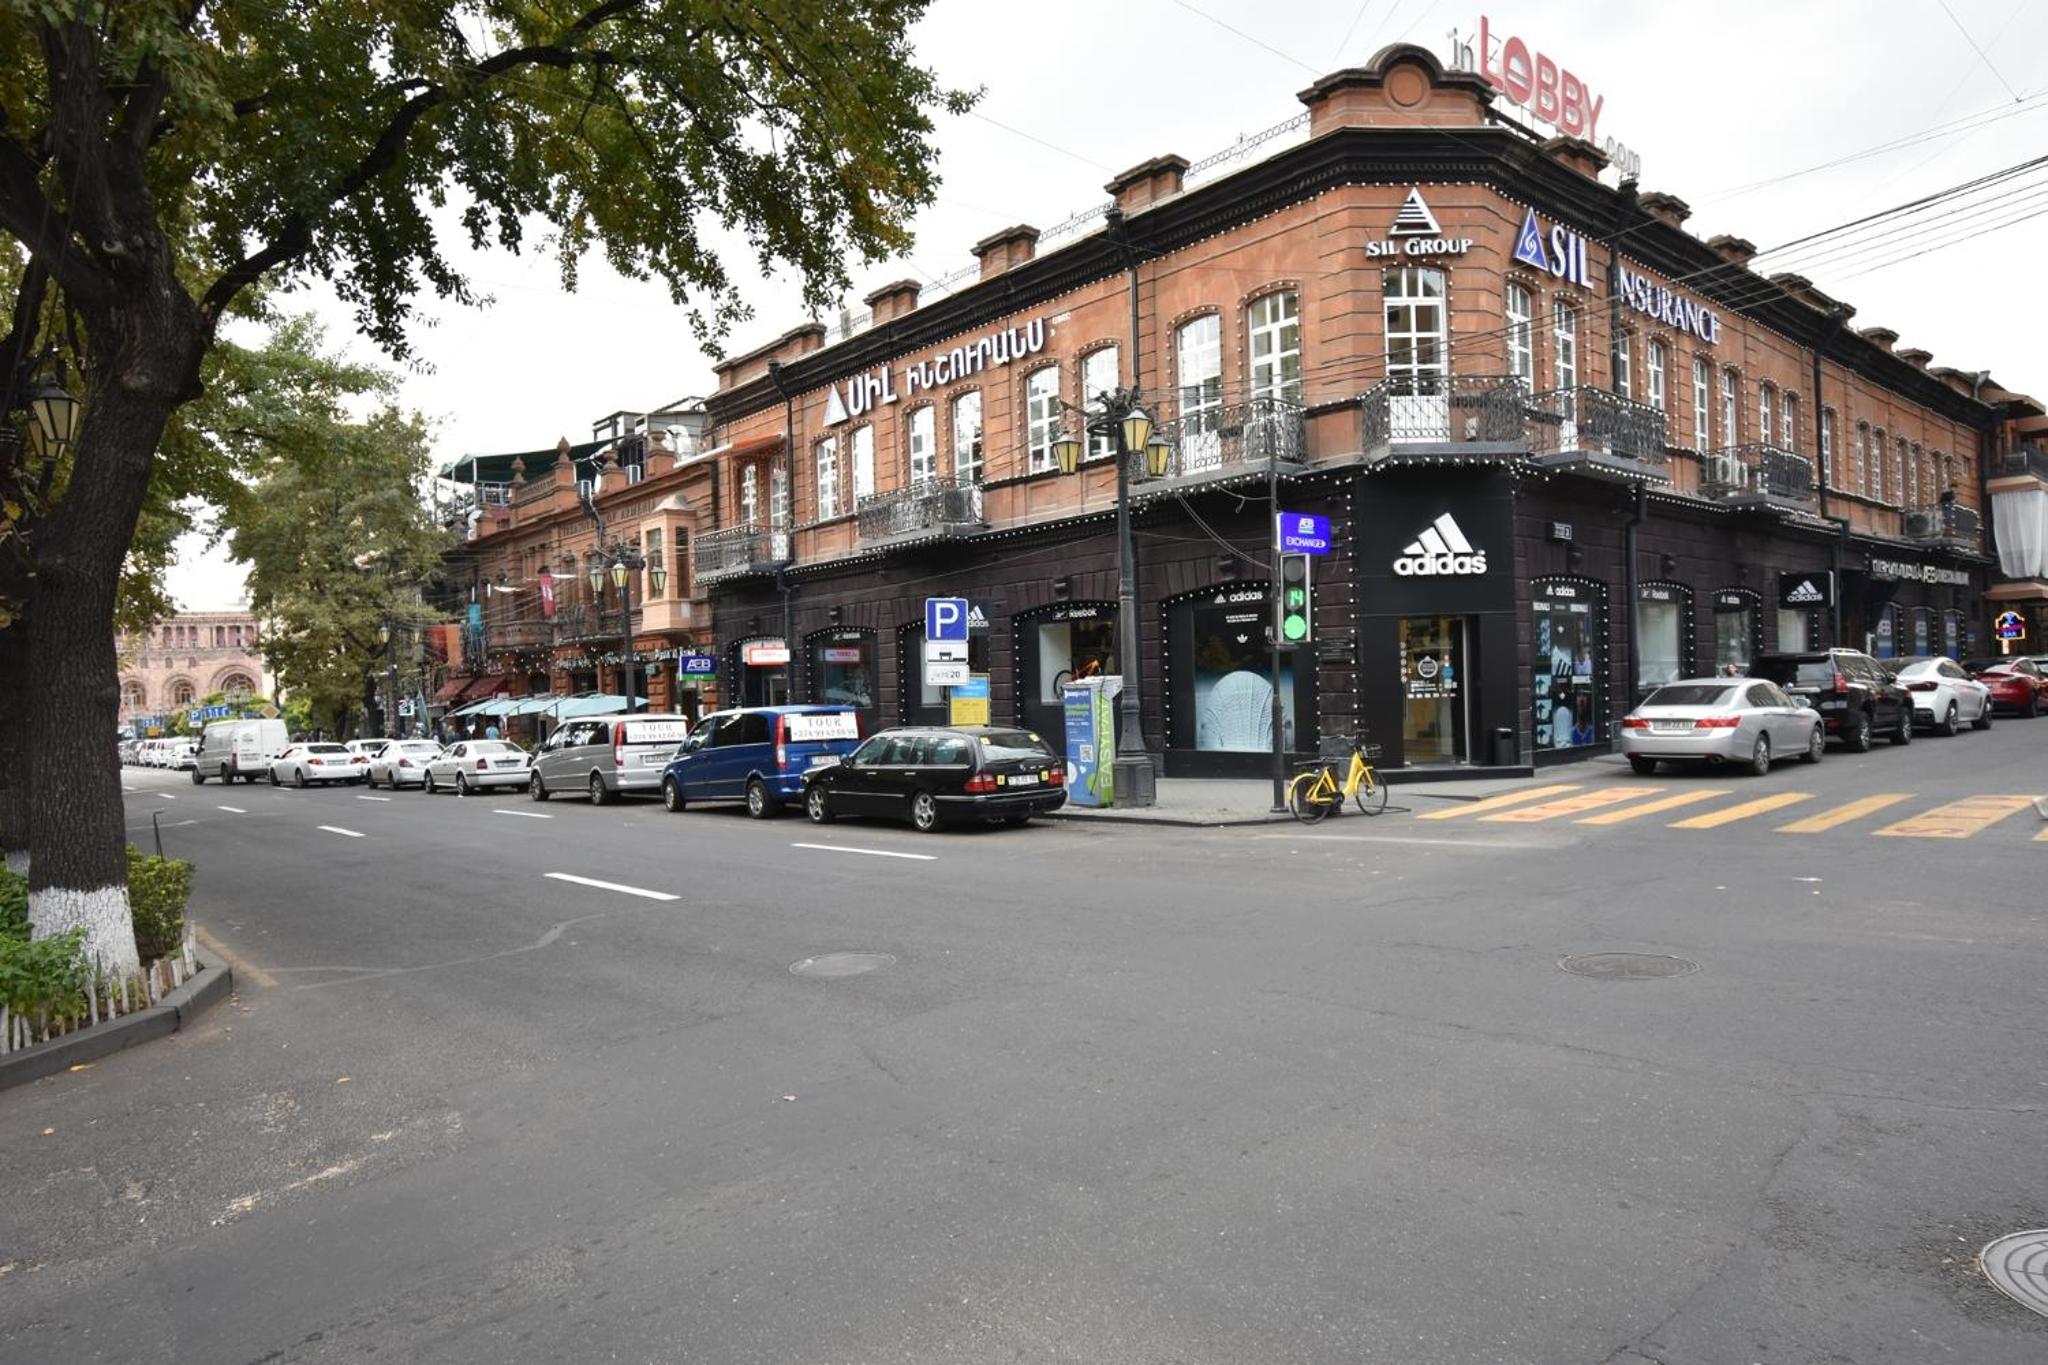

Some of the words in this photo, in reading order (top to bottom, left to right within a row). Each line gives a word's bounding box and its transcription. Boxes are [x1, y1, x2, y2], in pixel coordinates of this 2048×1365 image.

[1479, 15, 1604, 147] LOBBY
[1365, 240, 1401, 257] SIL
[1404, 237, 1474, 256] GROUP
[1550, 225, 1594, 290] SIL
[1618, 266, 1723, 346] NSURANCE
[847, 365, 898, 417] ՍԻԼ
[1393, 552, 1488, 576] adidas
[1229, 591, 1264, 603] adidas
[1289, 589, 1305, 608] 14
[1554, 585, 1577, 598] adidas
[1786, 591, 1824, 603] adidas
[934, 602, 960, 638] P
[1068, 607, 1098, 618] Reebok
[967, 619, 990, 628] didas
[641, 723, 673, 732] TOUR
[807, 718, 842, 728] TOUR
